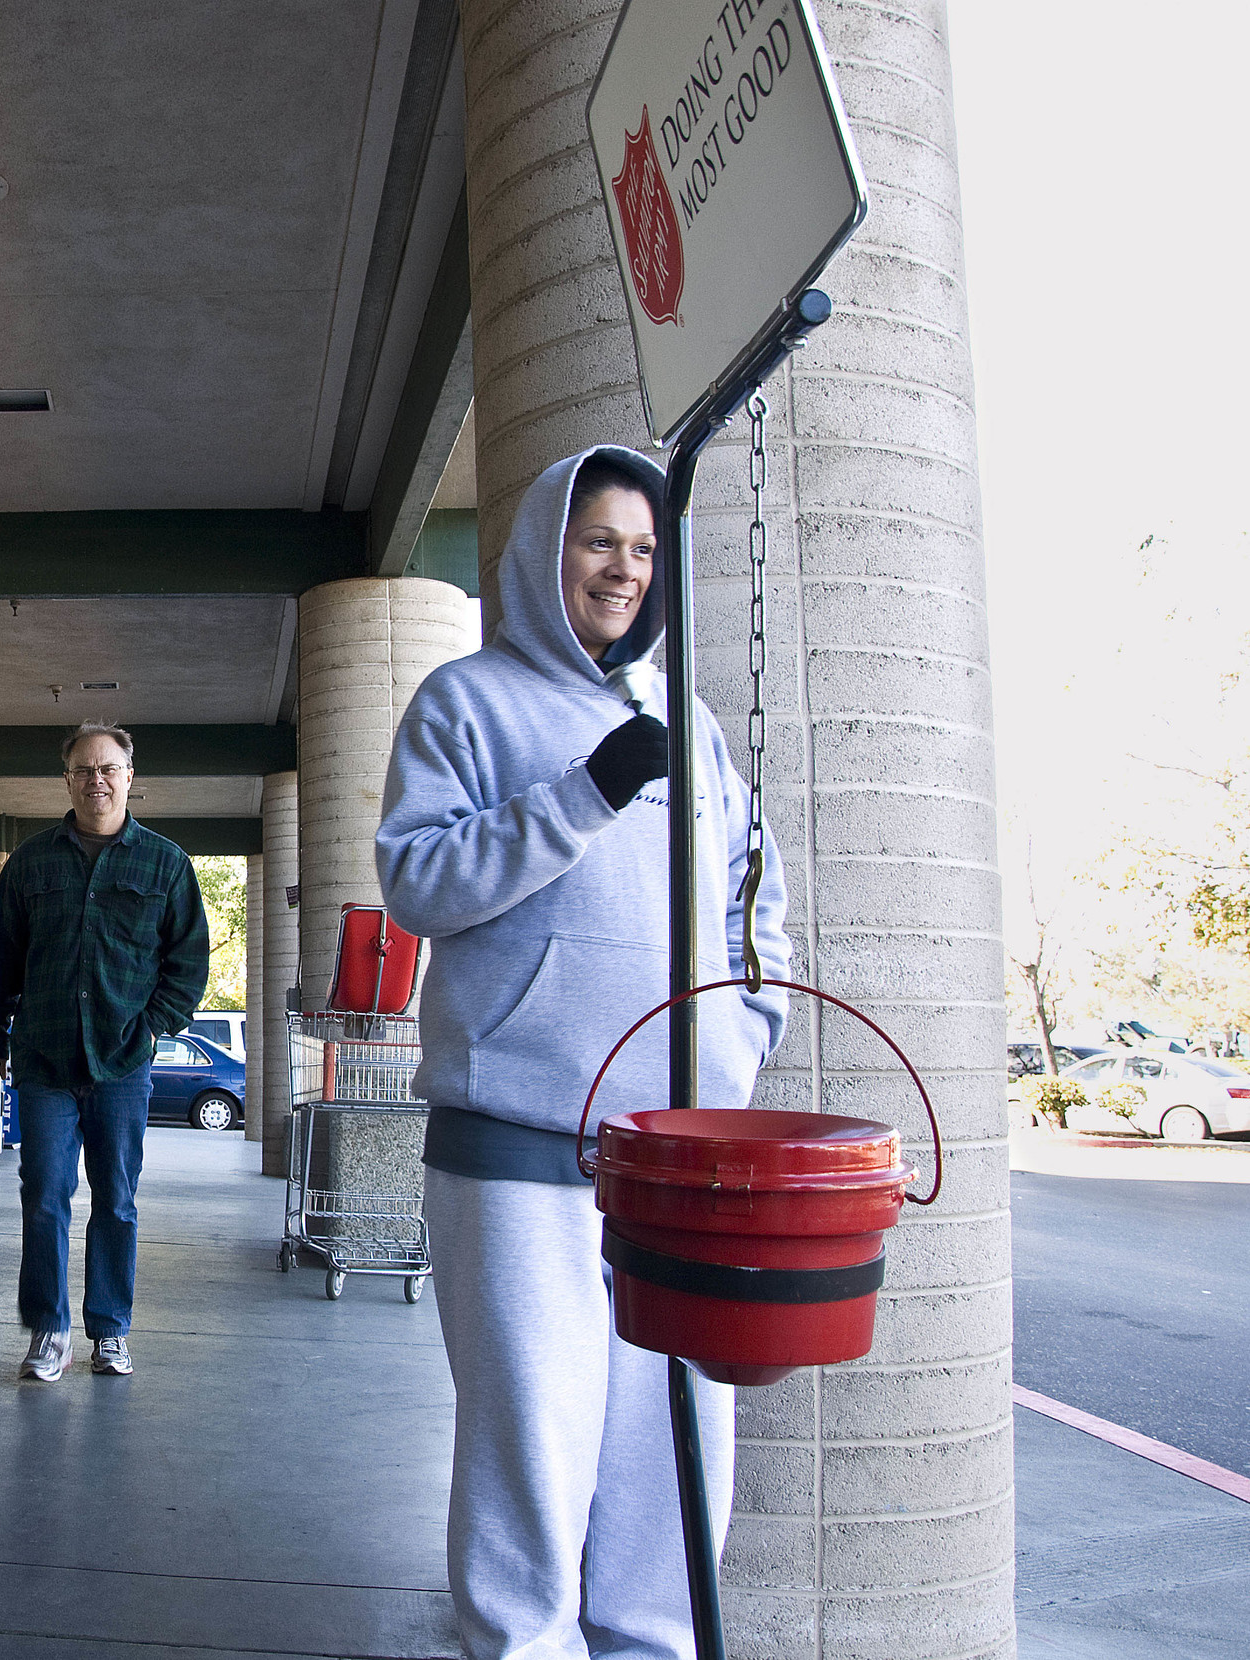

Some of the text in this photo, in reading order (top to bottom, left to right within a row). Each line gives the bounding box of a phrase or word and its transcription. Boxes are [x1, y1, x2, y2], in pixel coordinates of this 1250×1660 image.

[660, 0, 764, 172] DOING TH
[678, 18, 790, 231] MOST GOOD
[625, 152, 639, 229] THE
[633, 134, 657, 300] SALVATION
[652, 188, 670, 304] ARMY
